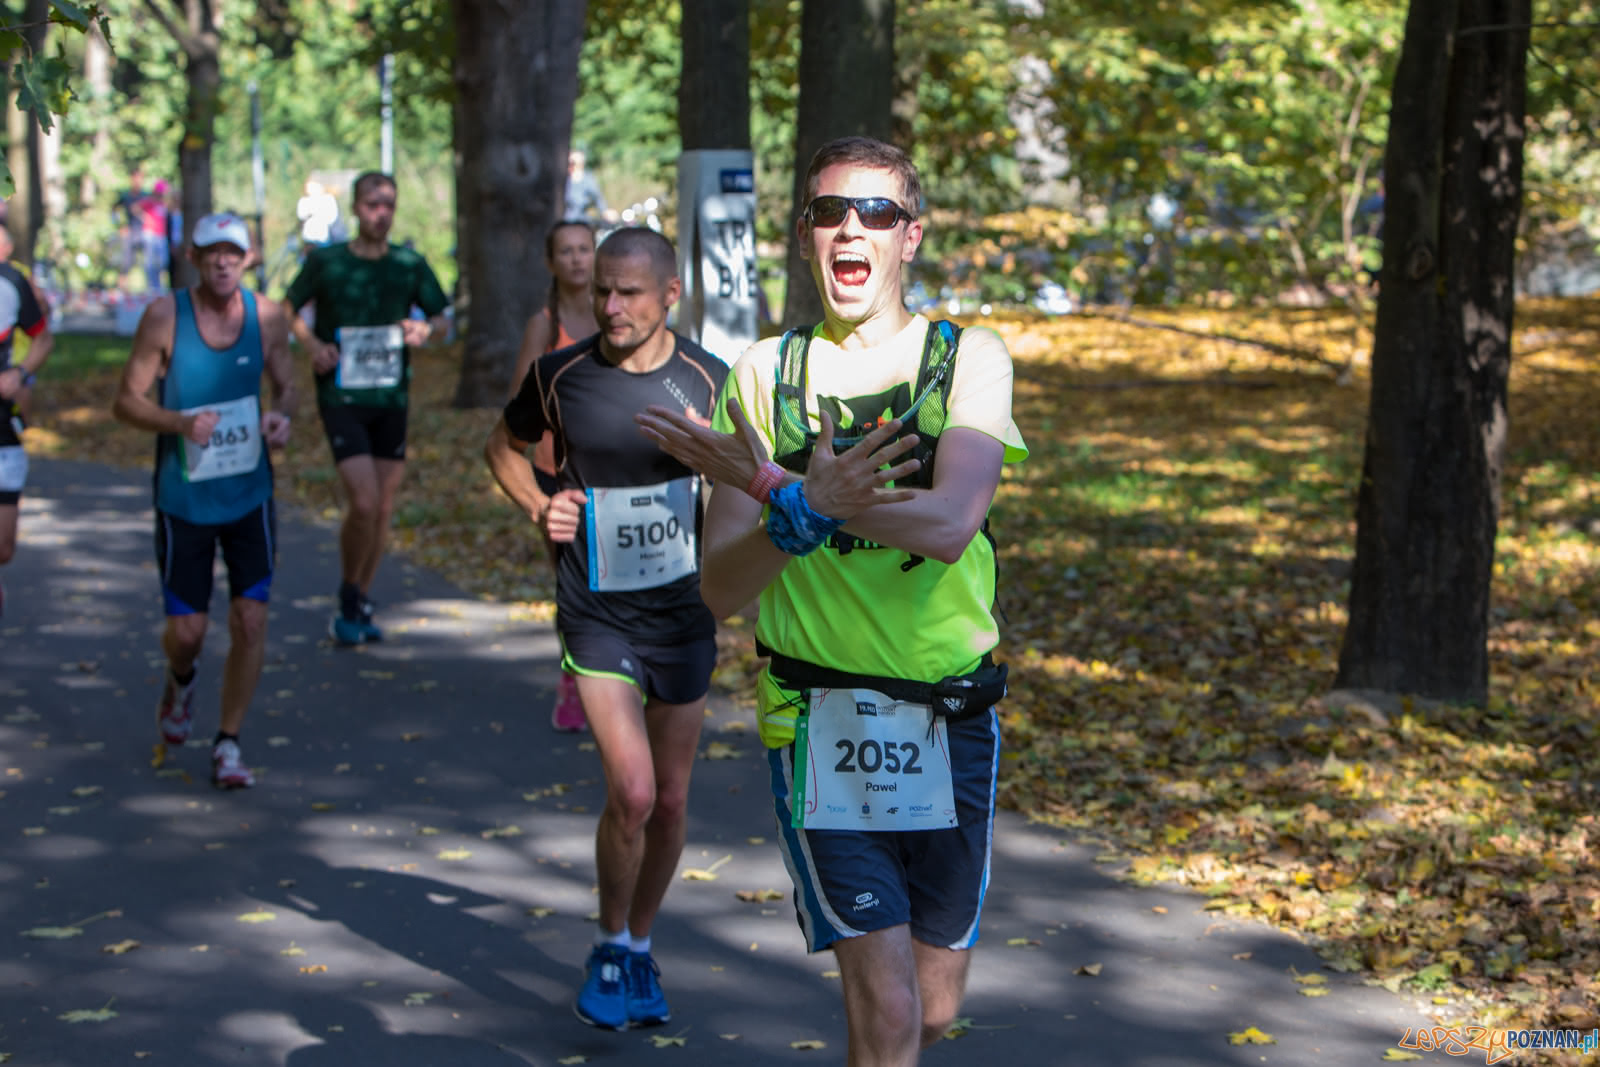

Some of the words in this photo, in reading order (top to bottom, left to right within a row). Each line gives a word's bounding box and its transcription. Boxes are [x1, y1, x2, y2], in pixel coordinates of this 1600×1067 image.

[200, 425, 249, 449] 863
[617, 516, 679, 549] 5100
[835, 739, 923, 774] 2052
